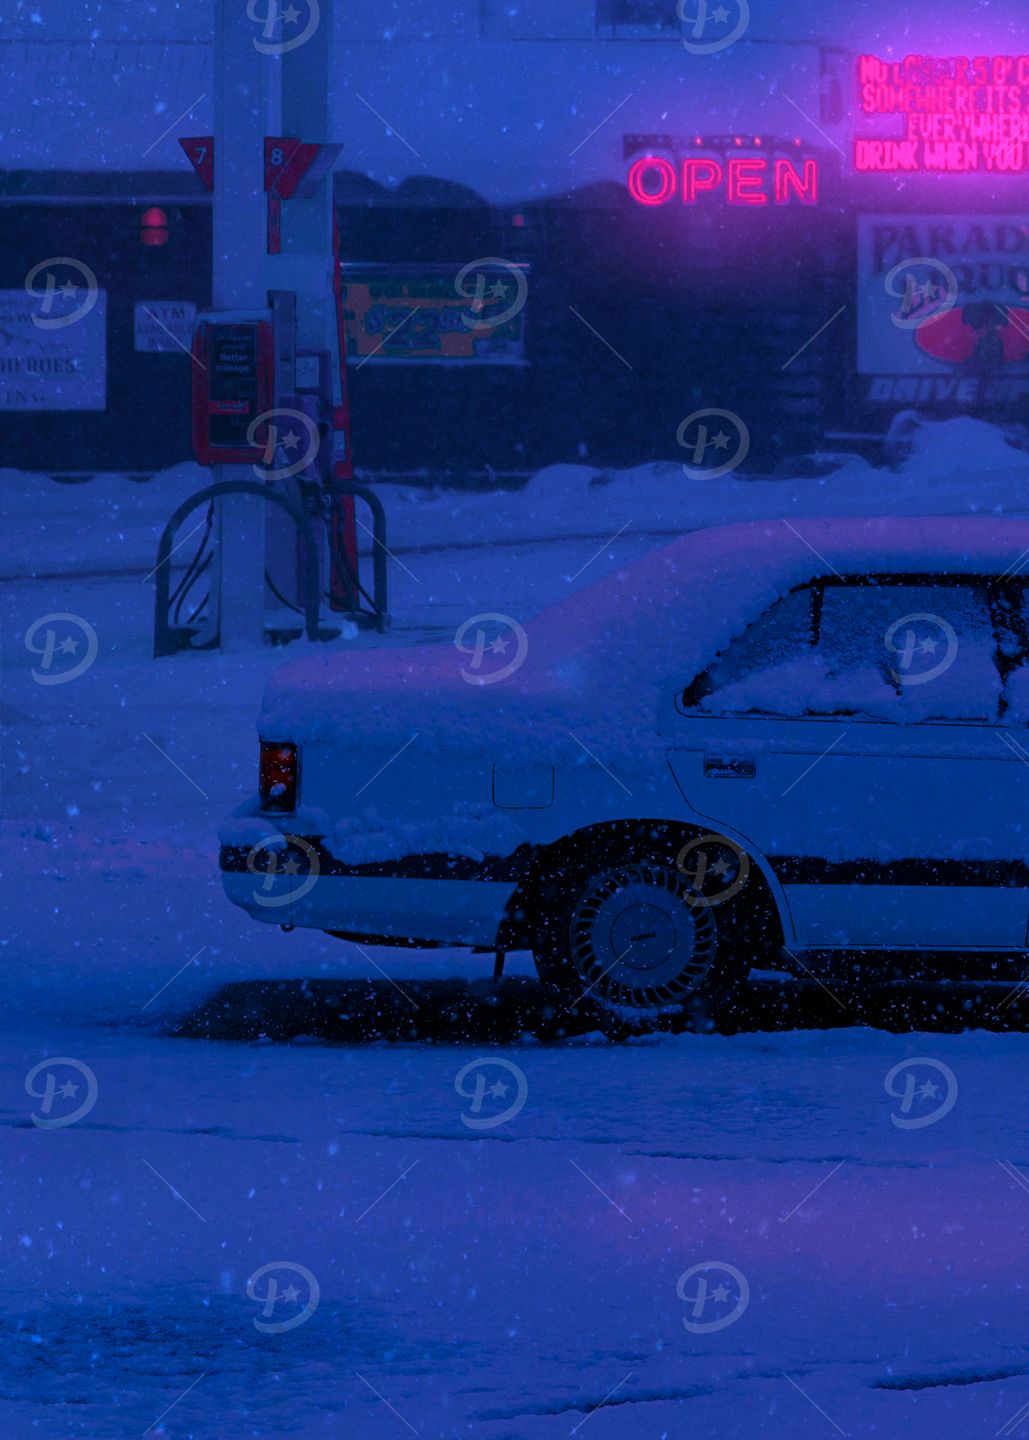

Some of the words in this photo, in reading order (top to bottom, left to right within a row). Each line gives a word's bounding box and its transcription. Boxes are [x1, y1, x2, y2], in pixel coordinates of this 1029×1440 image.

[195, 147, 207, 165] 7
[271, 148, 283, 165] 8
[854, 140, 920, 172] DRINK
[923, 140, 979, 172] WHEN
[627, 155, 820, 206] OPEN
